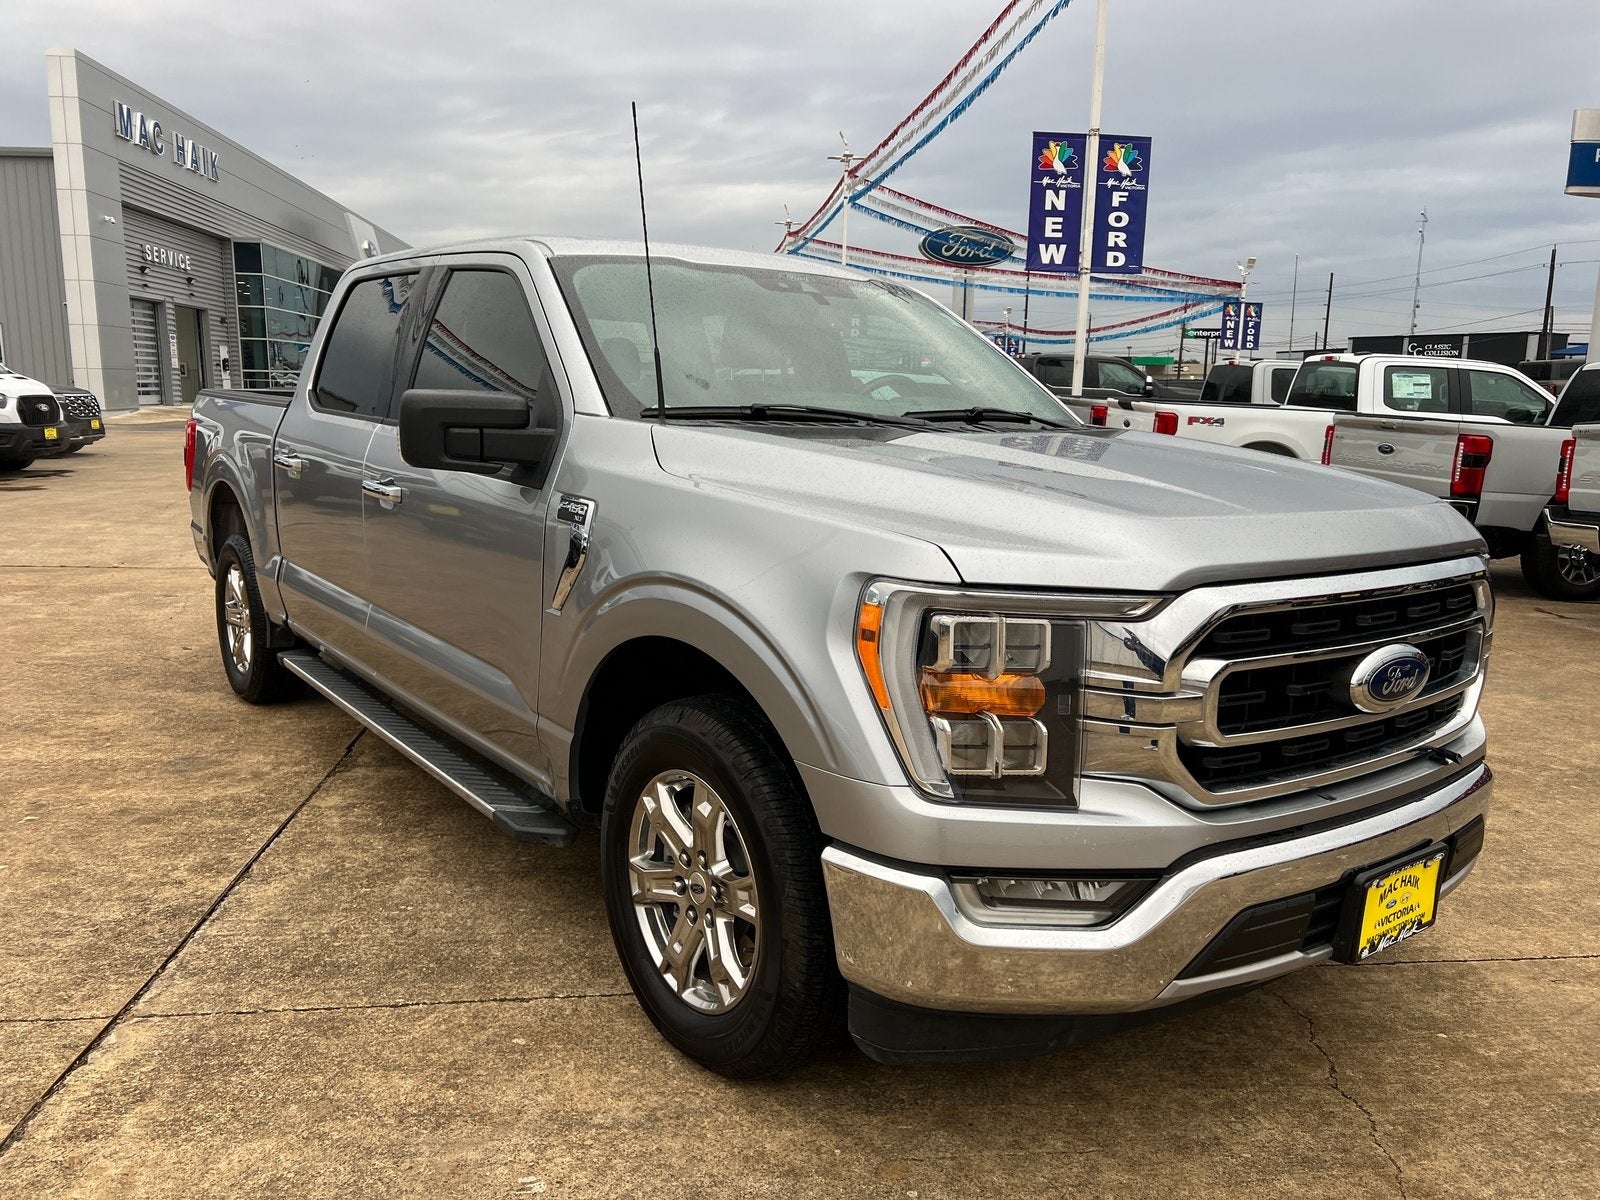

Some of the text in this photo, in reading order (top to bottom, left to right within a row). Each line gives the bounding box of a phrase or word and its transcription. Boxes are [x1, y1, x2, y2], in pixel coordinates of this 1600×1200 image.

[113, 100, 220, 182] MAC HAIK
[1039, 189, 1067, 265] NEW
[1106, 191, 1130, 267] FORD
[145, 244, 191, 270] SERVICE
[941, 233, 998, 258] Ford
[1186, 329, 1222, 338] enterpri
[1224, 320, 1235, 348] NEW
[1246, 321, 1255, 349] FORD
[1187, 416, 1225, 426] FX4
[1382, 664, 1420, 696] Ford
[1378, 878, 1400, 907] MAC
[1400, 874, 1420, 889] HAIK
[1380, 904, 1415, 926] VICTORIA
